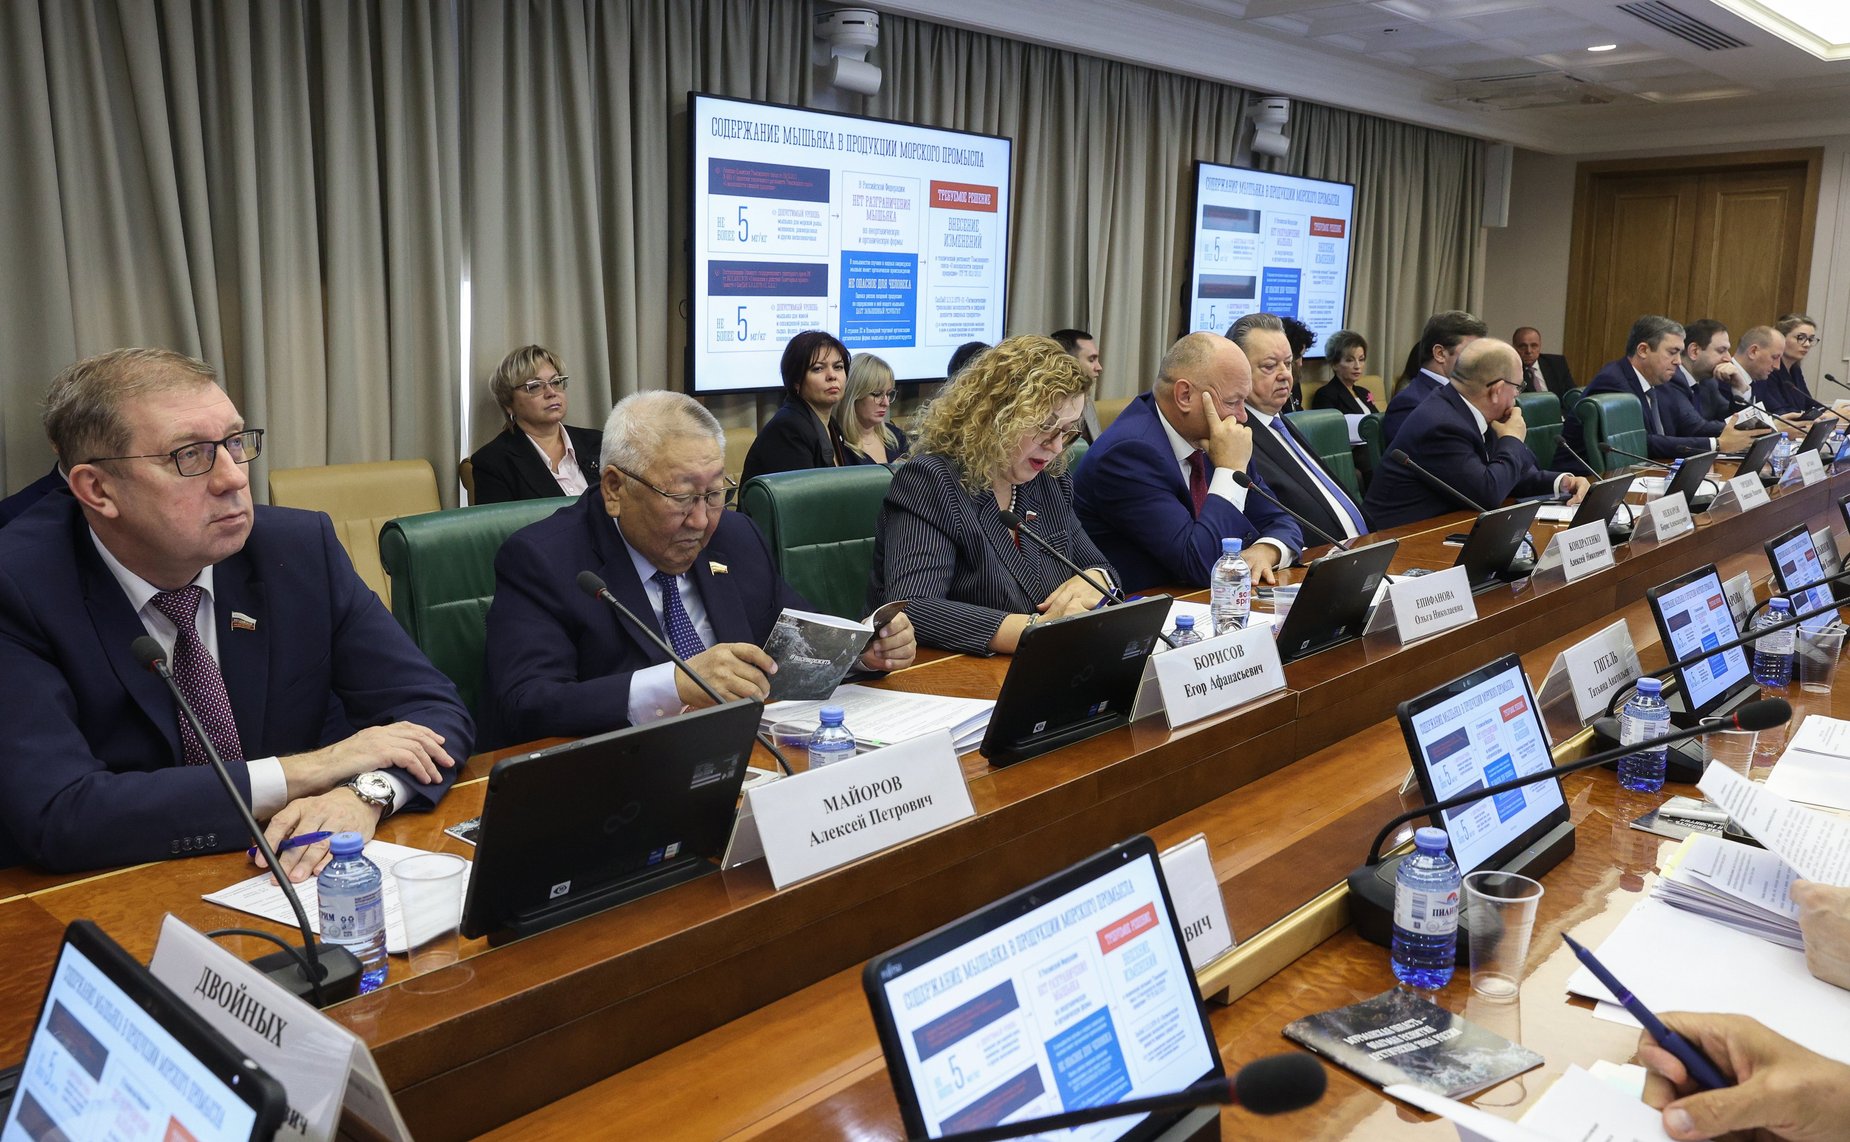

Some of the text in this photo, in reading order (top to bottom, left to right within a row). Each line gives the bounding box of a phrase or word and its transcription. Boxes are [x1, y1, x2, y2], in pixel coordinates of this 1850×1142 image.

[711, 116, 985, 168] СОДЕРЖАНИЕ МЫШЬЯКА В ПРОДУКЦИИ МОРСКОГО ПРОМЫСЛА
[852, 194, 911, 210] НЕТ РАЗГРАНИЧЕНИЯ
[738, 206, 748, 242] 5
[866, 209, 896, 222] МЫШЬЯКА
[948, 217, 980, 232] ВНЕСЕНИЕ
[944, 233, 982, 249] ИЗМЕНЕНИЙ
[1213, 236, 1221, 262] 5
[737, 305, 747, 342] 5
[1209, 305, 1216, 330] 5
[1415, 590, 1455, 609] ЕПИФАНОВА
[1414, 604, 1464, 624] Ольга Николаевна
[1193, 643, 1245, 671] БОРИСОВ
[1593, 650, 1619, 675] ГИГЕЛЬ
[1184, 662, 1264, 698] Егор Афанасьевич
[1588, 681, 1609, 699] Татьяна
[823, 775, 903, 815] МАЙОРОВ
[809, 793, 934, 848] Алексей Петрович
[194, 965, 289, 1049] ДВОЙНЫХ
[947, 1054, 965, 1090] 5
